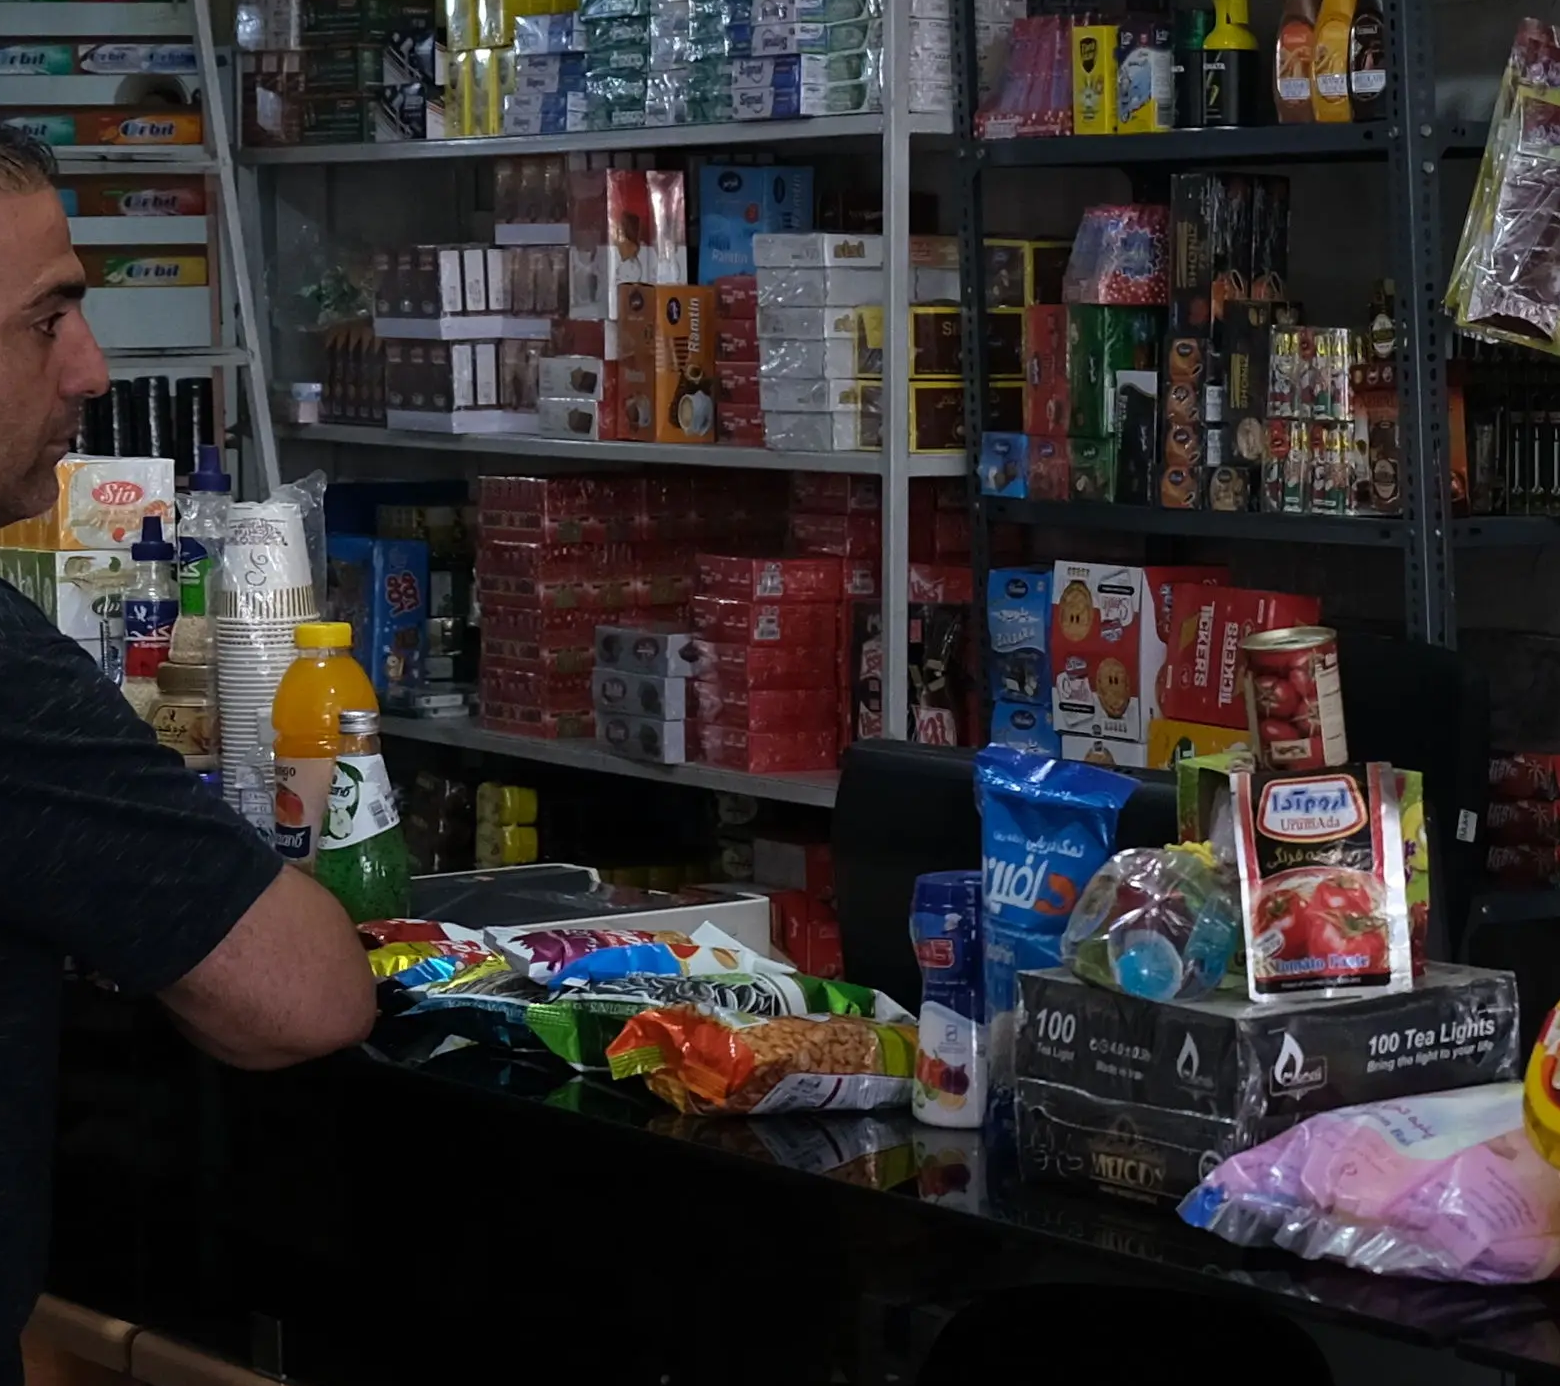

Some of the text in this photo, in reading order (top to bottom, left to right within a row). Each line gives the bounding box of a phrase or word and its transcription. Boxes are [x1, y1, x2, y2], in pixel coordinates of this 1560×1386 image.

[120, 118, 177, 141] Orbit
[125, 191, 180, 213] Orbit
[126, 259, 180, 281] Orbit
[687, 296, 702, 354] Ramtin
[1036, 1010, 1075, 1044] 100
[1368, 1016, 1497, 1056] 100 Tea Lights
